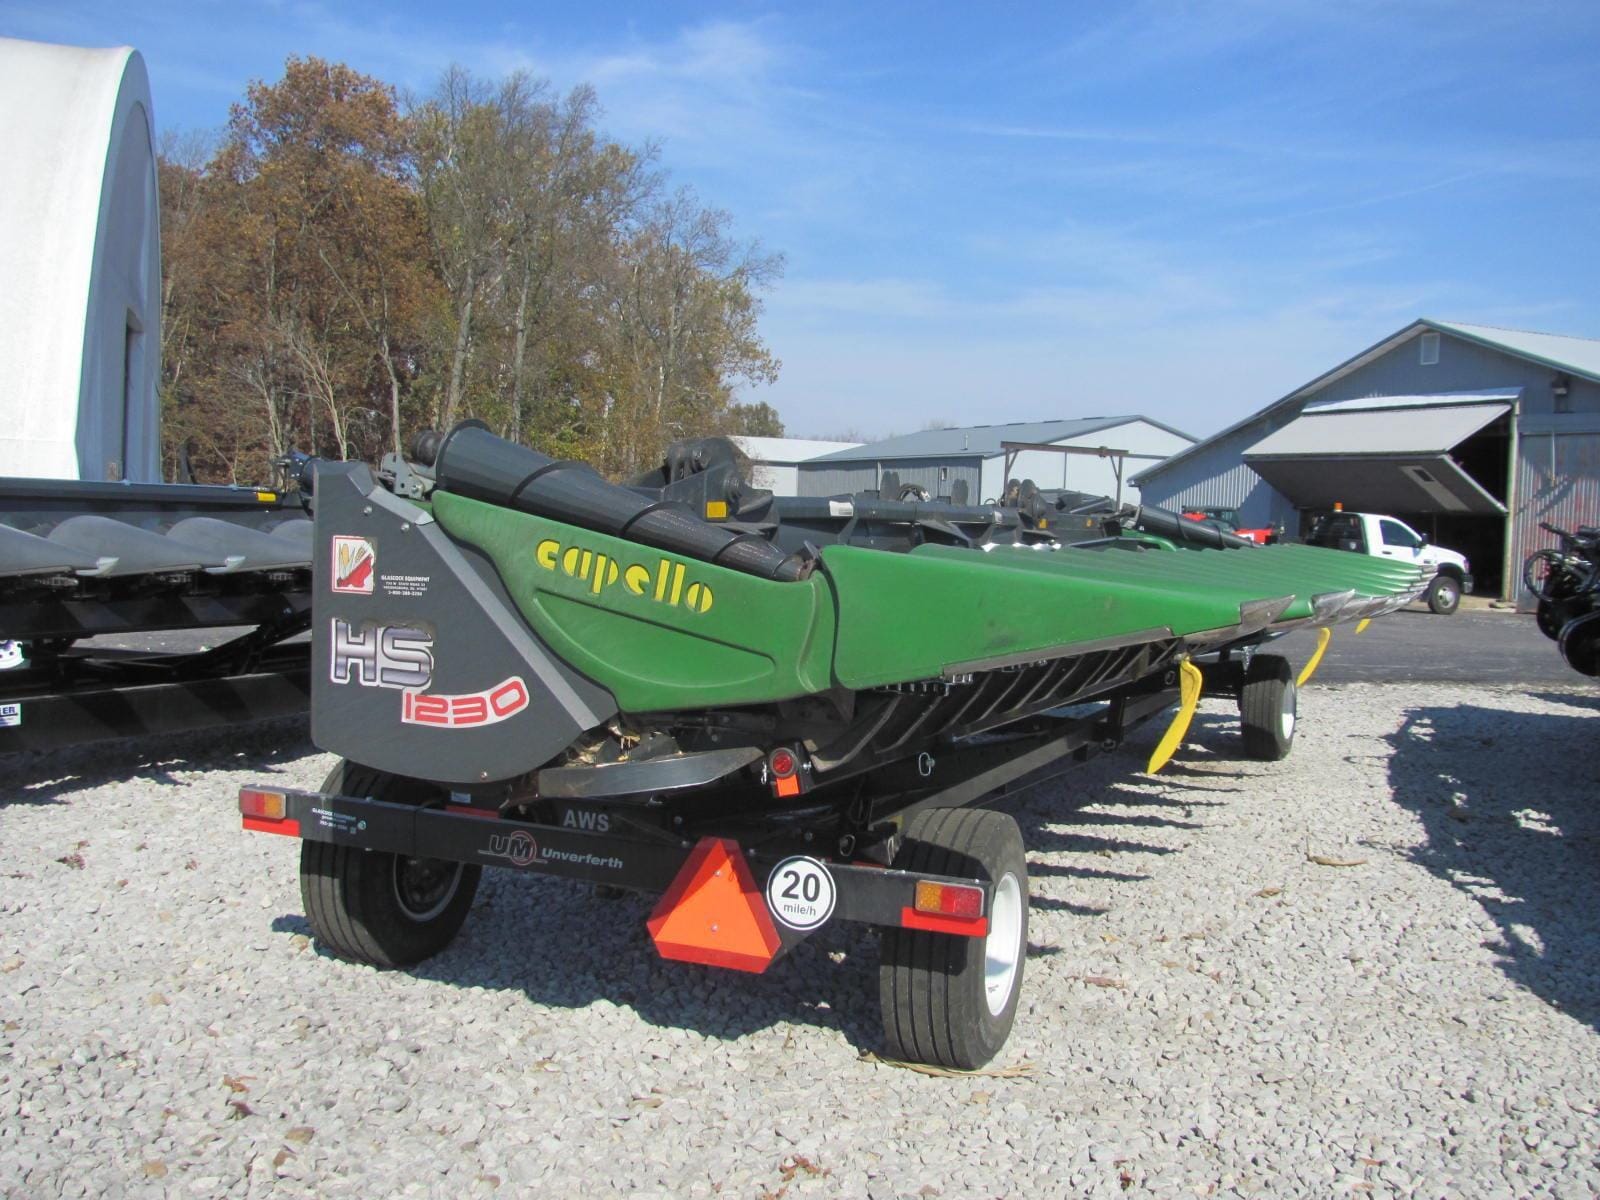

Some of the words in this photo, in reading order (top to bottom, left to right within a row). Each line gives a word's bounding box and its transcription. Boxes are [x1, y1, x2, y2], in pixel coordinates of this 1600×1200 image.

[536, 538, 713, 614] capello
[332, 618, 433, 689] HS
[404, 679, 528, 726] 1230
[563, 809, 609, 832] AWS
[489, 834, 534, 861] UM
[541, 847, 624, 869] Unverferth
[781, 870, 820, 902] 20
[783, 904, 816, 916] mile/h
